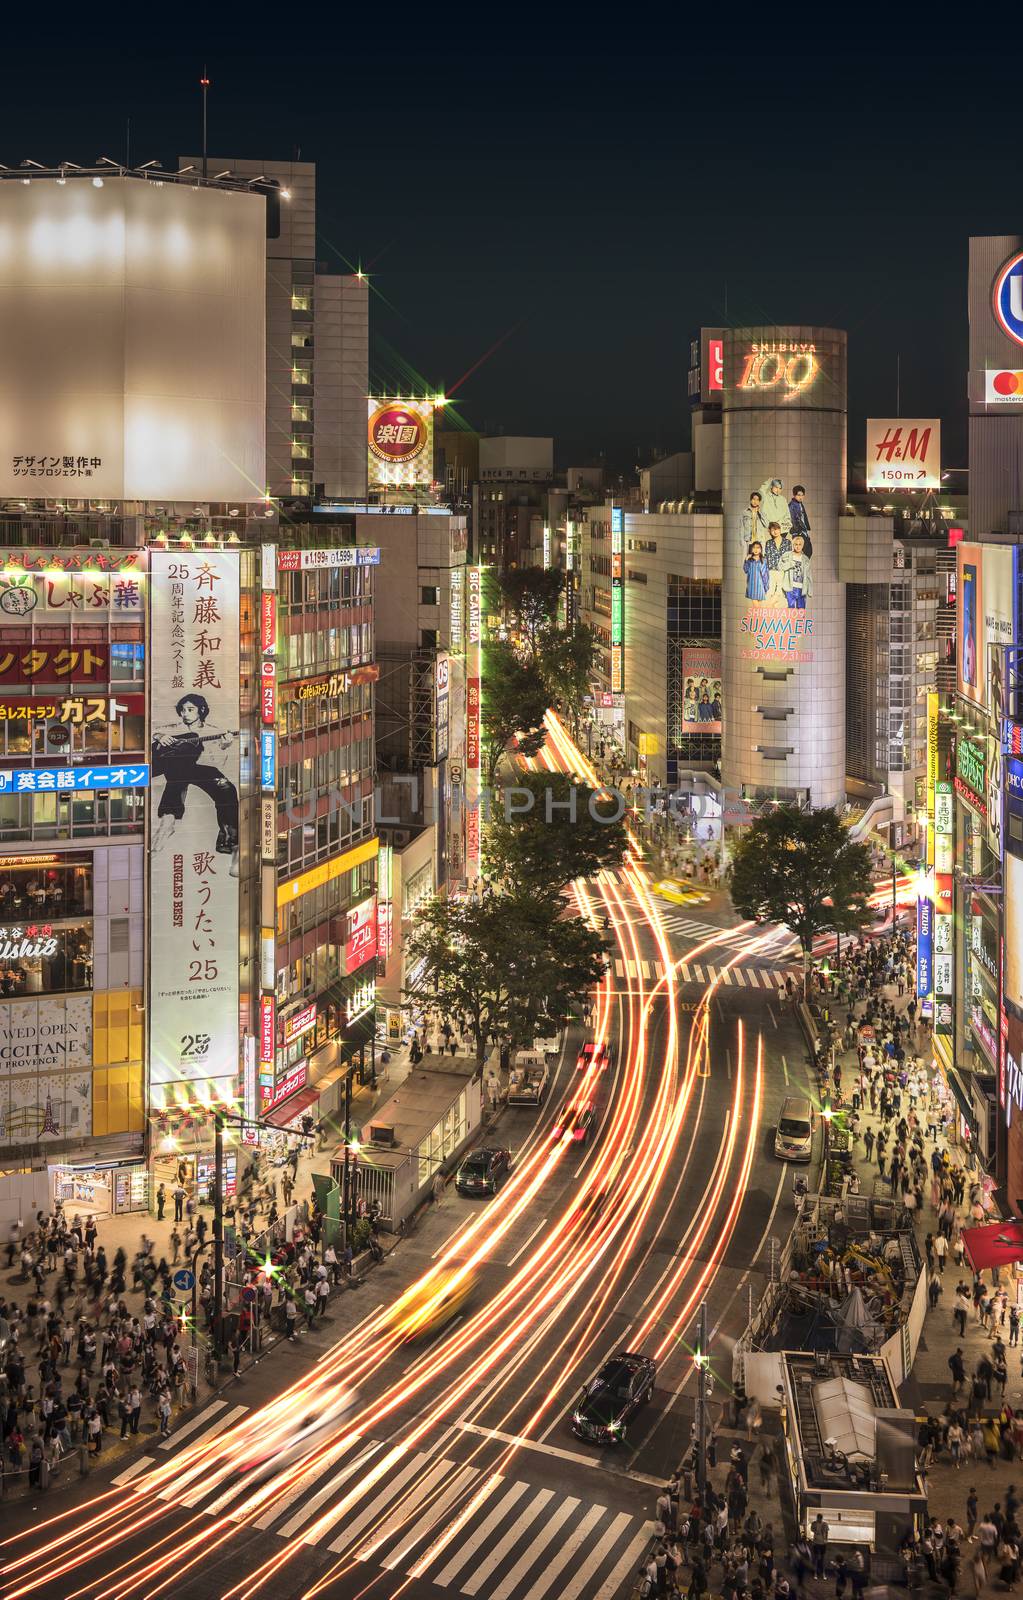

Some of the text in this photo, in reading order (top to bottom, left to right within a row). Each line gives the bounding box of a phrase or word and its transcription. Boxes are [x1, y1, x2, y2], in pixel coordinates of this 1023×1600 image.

[752, 344, 817, 353] SHIBUYA
[736, 353, 820, 401] 109
[377, 424, 418, 445] 楽園
[875, 428, 932, 462] H&M
[13, 457, 102, 469] デザイン製作中
[881, 471, 914, 480] 150m
[48, 580, 139, 608] しゃぶ葉
[470, 572, 479, 643] BIC CAMERA
[192, 562, 222, 689] 斉藤和義
[740, 617, 814, 634] SUMMER
[755, 635, 797, 651] SALE
[329, 673, 352, 696] ガスト
[60, 697, 129, 723] ガスト
[264, 688, 272, 717] ガスト
[469, 714, 478, 759] TaxFree
[17, 769, 145, 790] 英会話イーオン
[173, 854, 183, 927] SINGLES BEST
[351, 925, 371, 952] アコム
[347, 979, 377, 1021] LUSH
[3, 1023, 79, 1040] WED OPEN
[5, 1056, 58, 1068] PROVENCE
